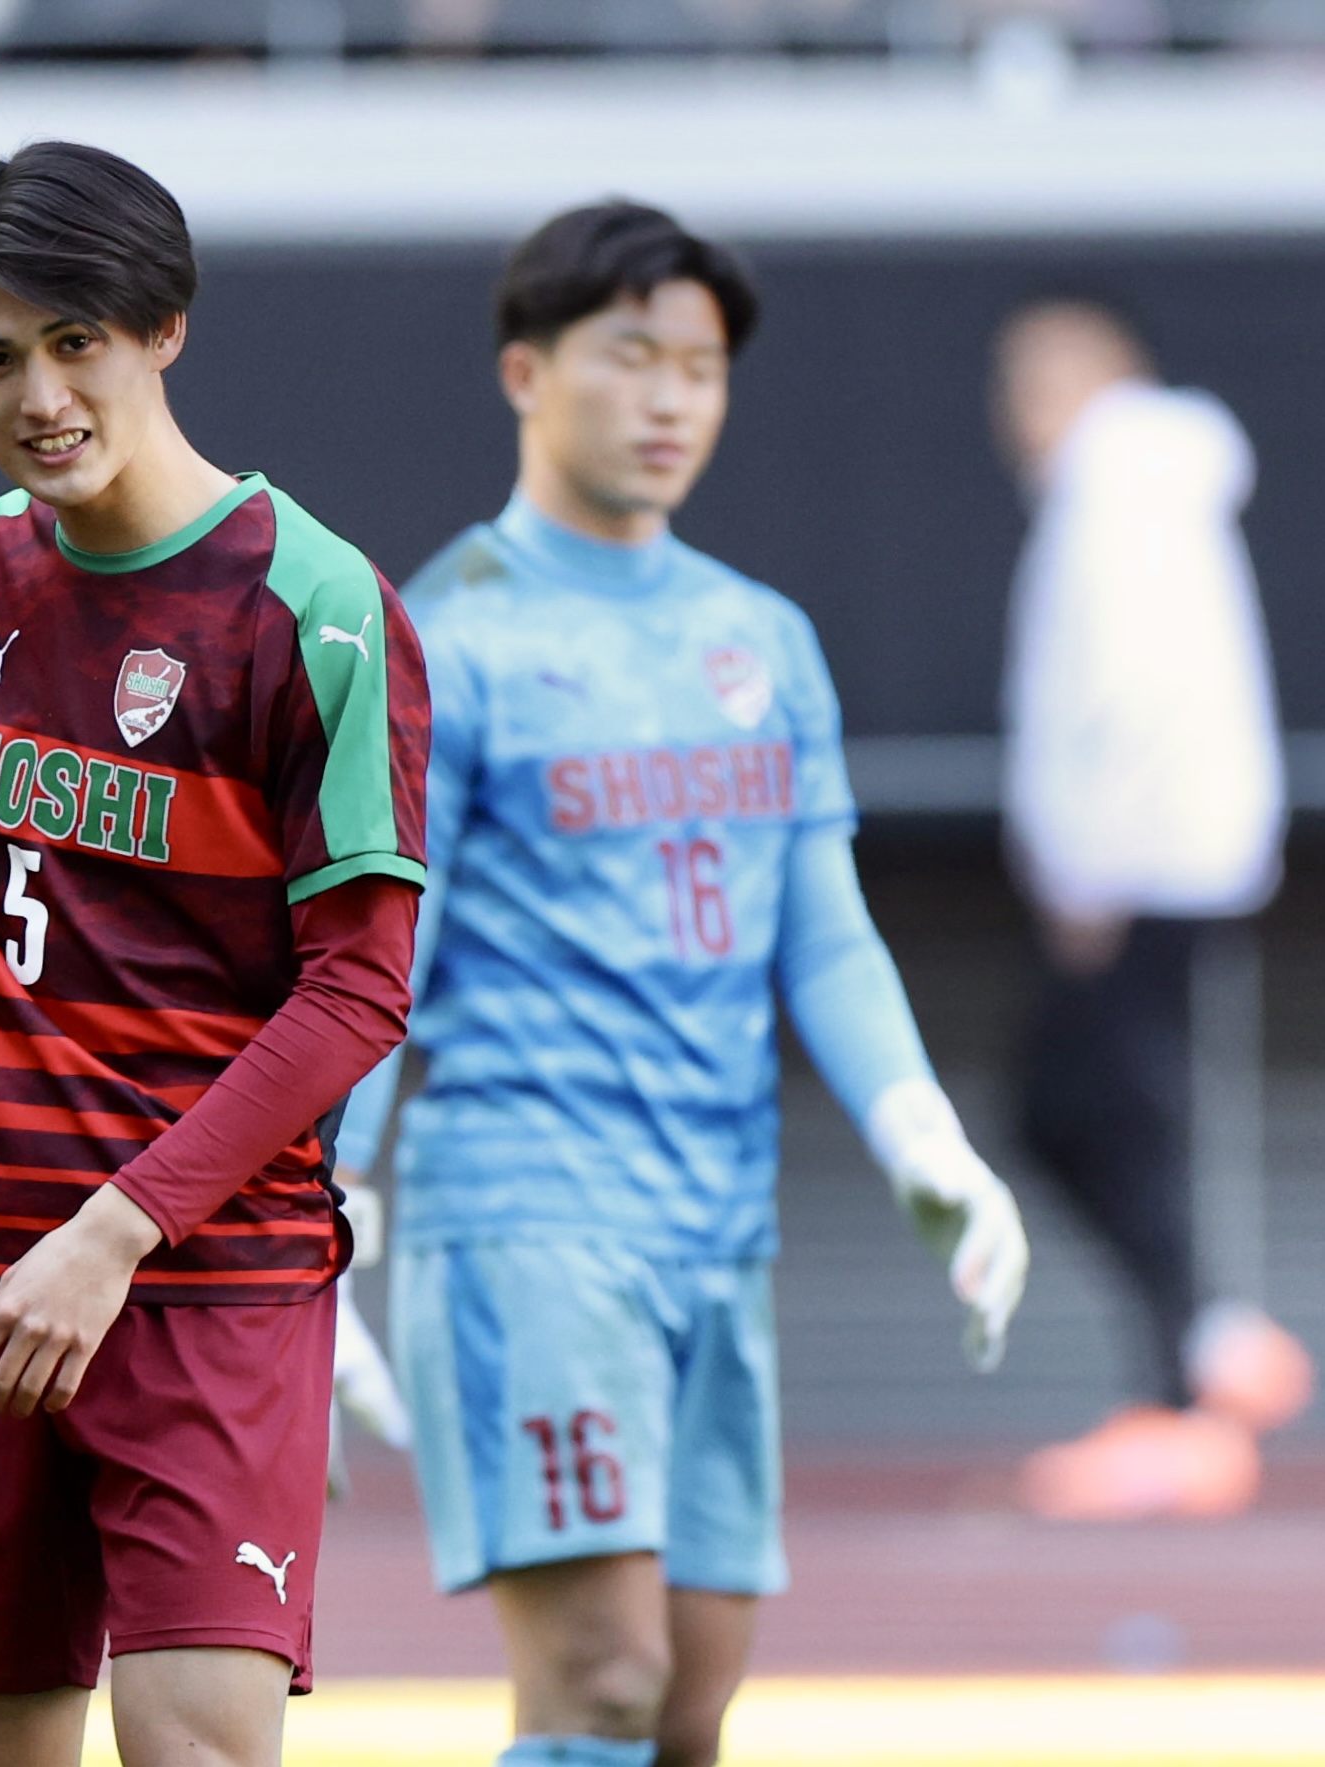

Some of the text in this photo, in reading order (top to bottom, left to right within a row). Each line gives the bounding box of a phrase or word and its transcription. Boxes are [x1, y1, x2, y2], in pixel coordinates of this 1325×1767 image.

[126, 671, 170, 698] SHOSHI
[547, 742, 794, 835] SHOSHI
[3, 843, 49, 985] 5
[656, 837, 734, 964] 16
[522, 1410, 627, 1531] 16
